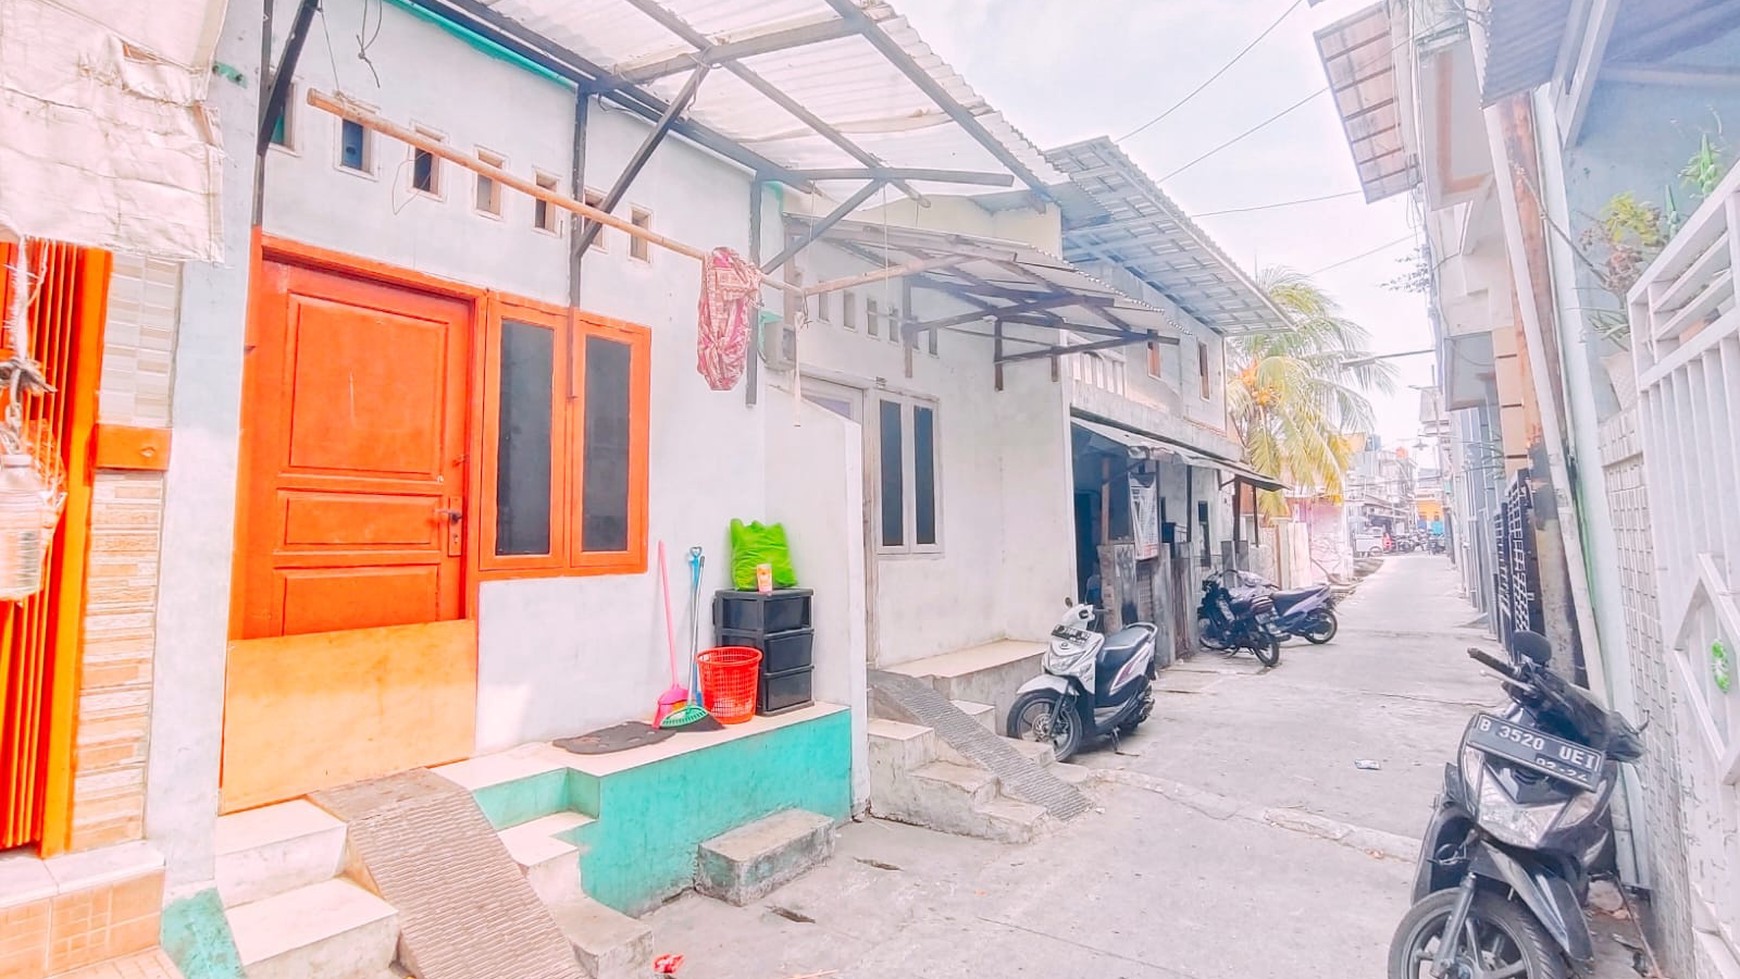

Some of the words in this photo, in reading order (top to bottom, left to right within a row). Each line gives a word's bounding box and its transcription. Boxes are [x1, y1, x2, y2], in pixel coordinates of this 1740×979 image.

[1479, 719, 1491, 732] B
[1499, 727, 1545, 750] 3520
[1559, 746, 1596, 769] UEI
